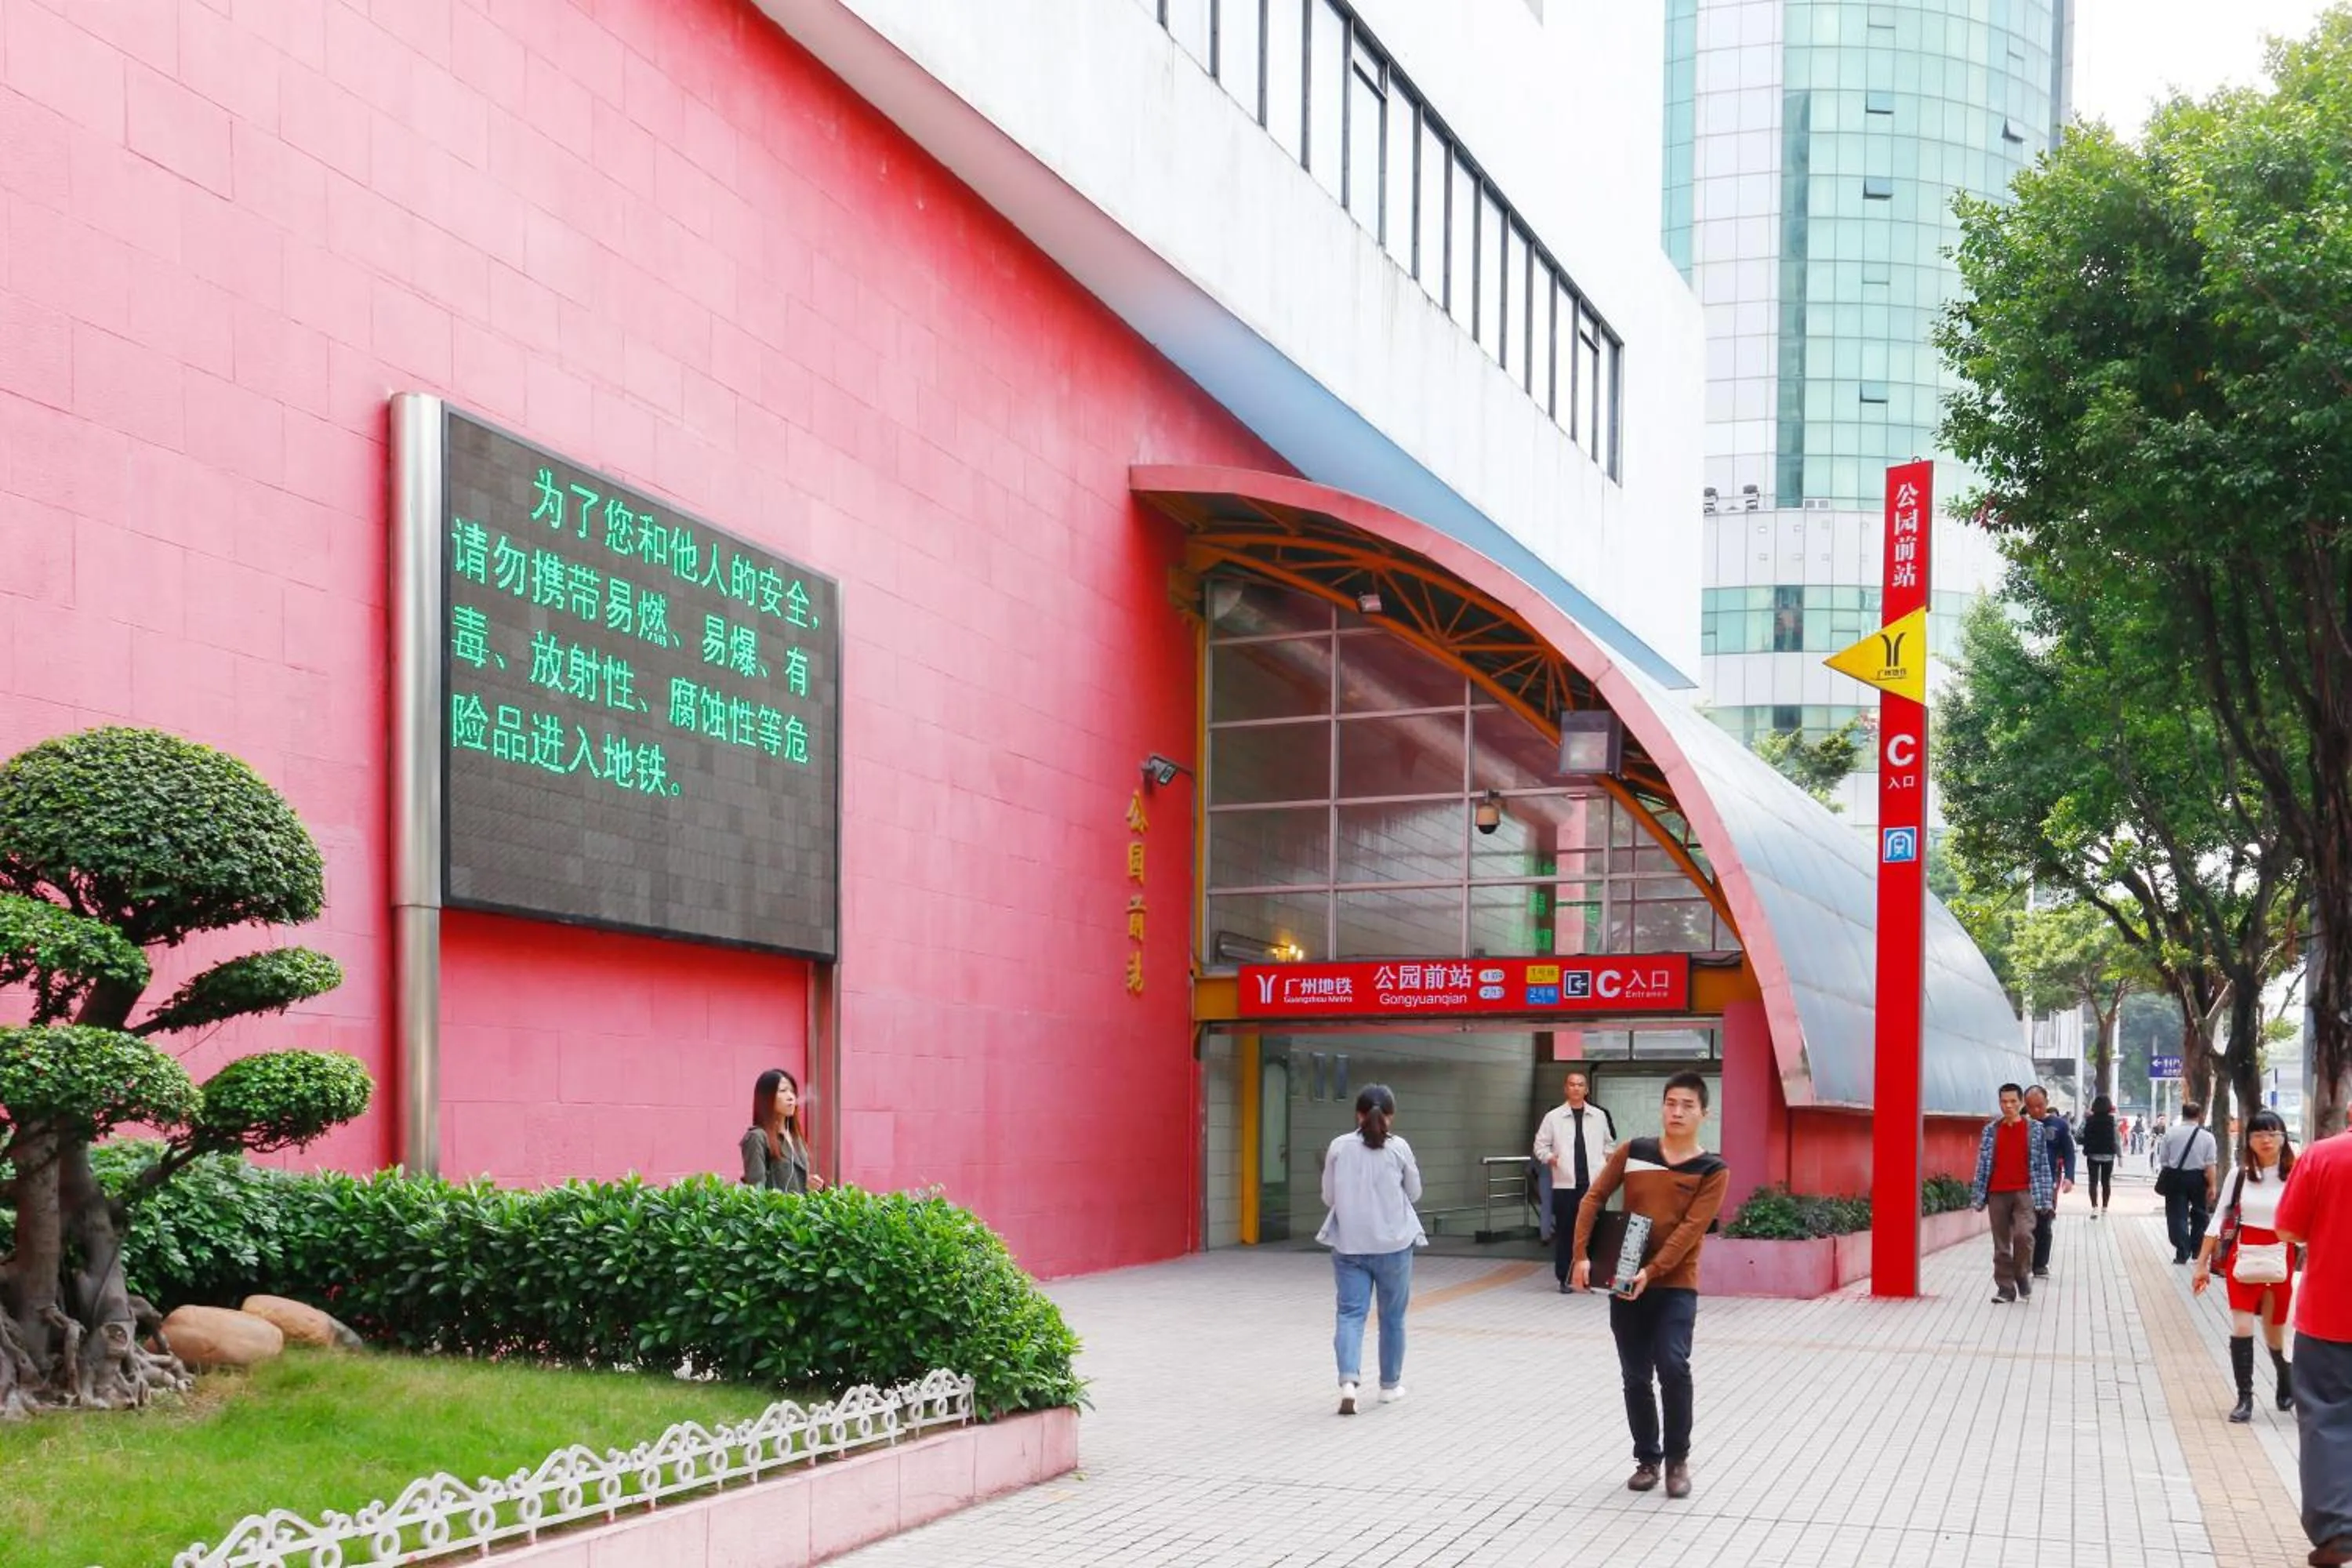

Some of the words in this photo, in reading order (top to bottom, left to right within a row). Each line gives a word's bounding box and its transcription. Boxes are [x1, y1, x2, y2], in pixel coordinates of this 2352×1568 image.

[1892, 481, 1918, 587] 公园前站
[451, 693, 681, 796] 险品进入地铁。
[1887, 733, 1916, 768] C
[1888, 775, 1915, 789] 入口
[1284, 977, 1353, 995] 广州地铁
[1373, 964, 1473, 989] 公园前站
[1596, 970, 1621, 998] C
[1626, 969, 1668, 989] 入口
[1379, 993, 1467, 1007] Gongyuanqian
